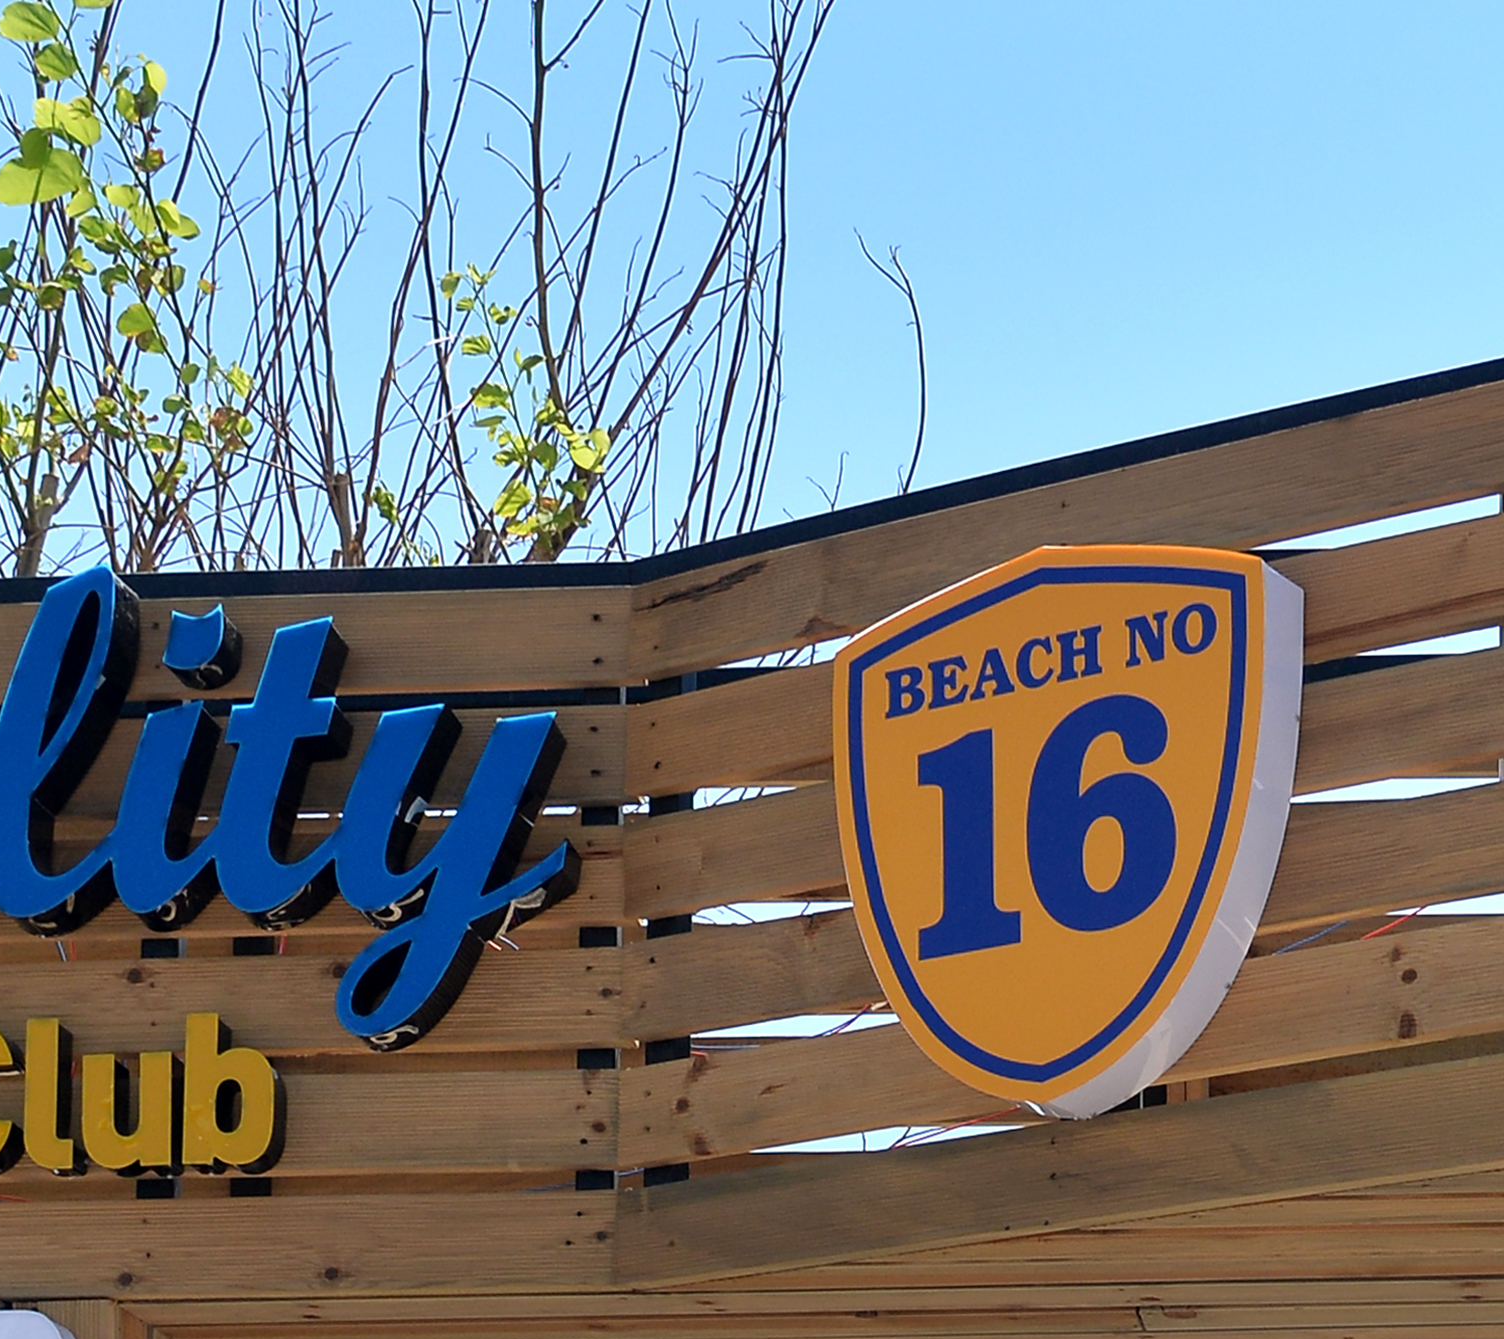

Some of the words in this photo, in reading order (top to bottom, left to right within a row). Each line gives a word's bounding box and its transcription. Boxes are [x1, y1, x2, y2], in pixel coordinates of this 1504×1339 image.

[884, 625, 1105, 720] BEACH
[1124, 602, 1218, 668] NO
[916, 693, 1177, 962] 16
